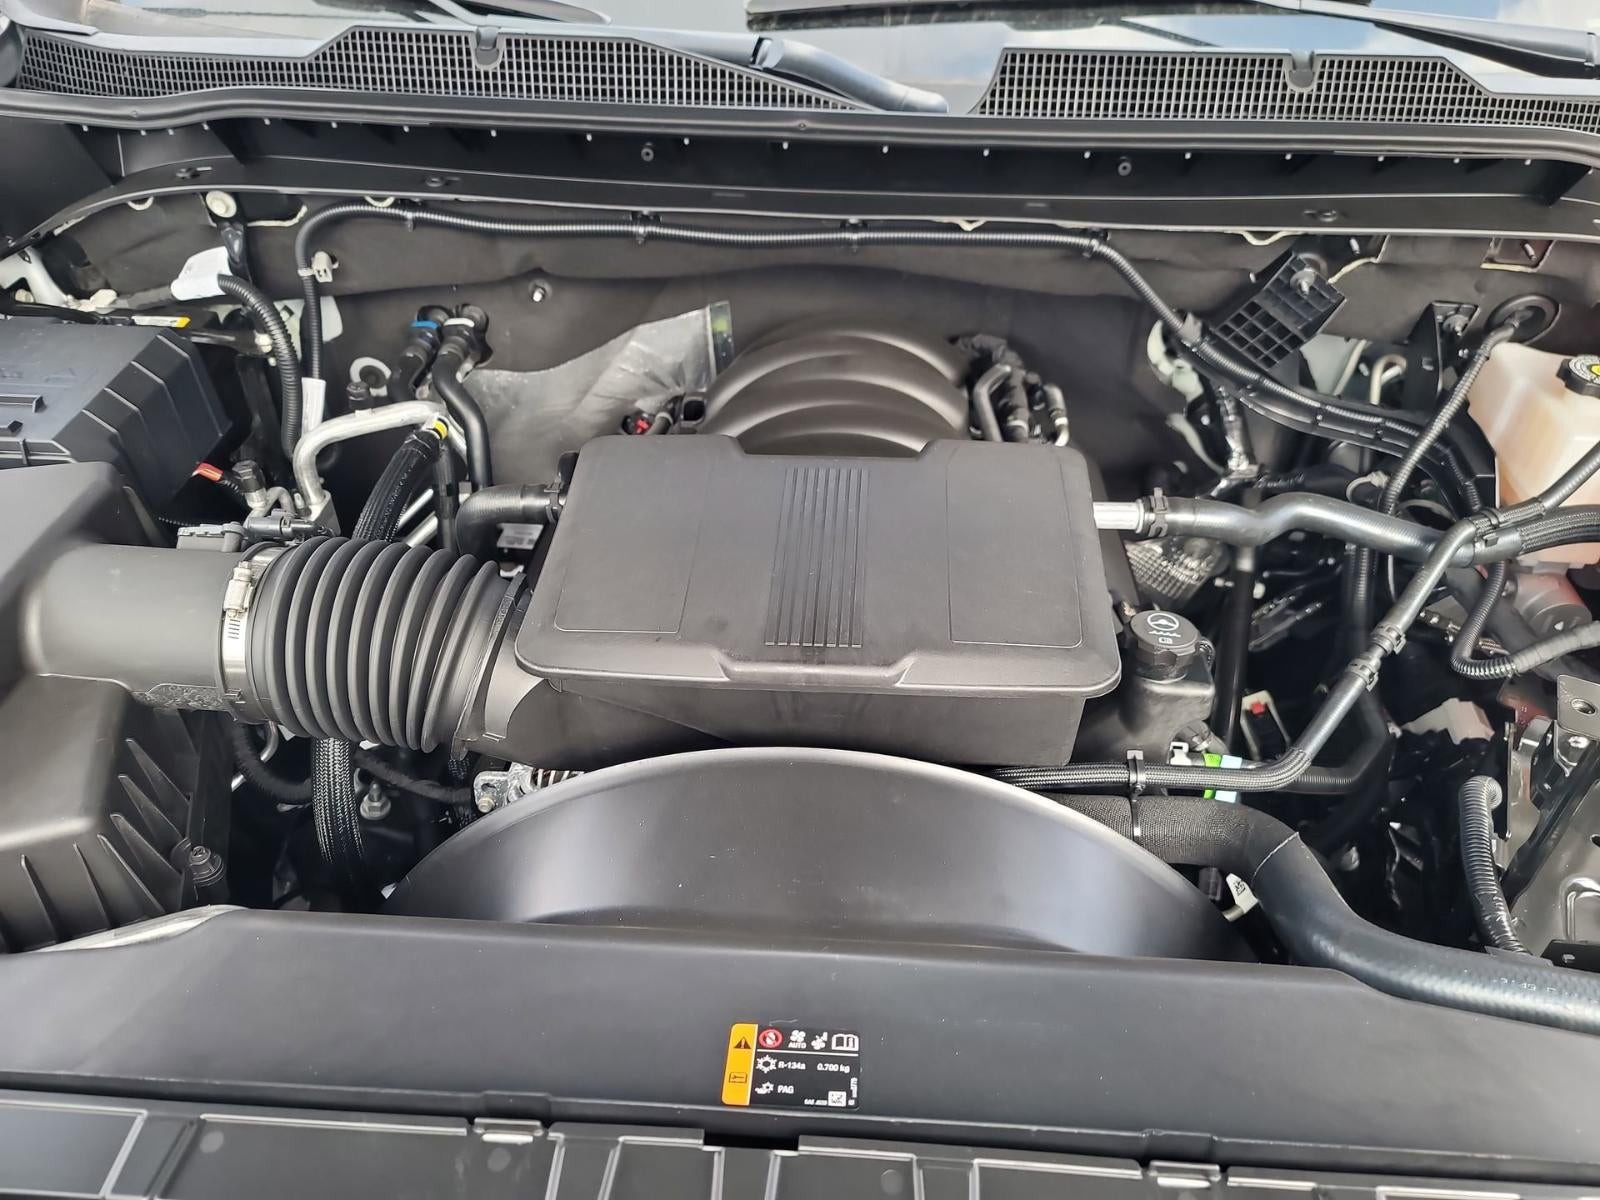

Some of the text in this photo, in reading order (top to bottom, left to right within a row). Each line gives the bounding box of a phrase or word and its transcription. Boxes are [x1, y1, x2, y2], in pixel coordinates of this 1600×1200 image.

[778, 1061, 806, 1070] R-134a
[840, 1064, 850, 1073] kg
[777, 1085, 794, 1094] PAG
